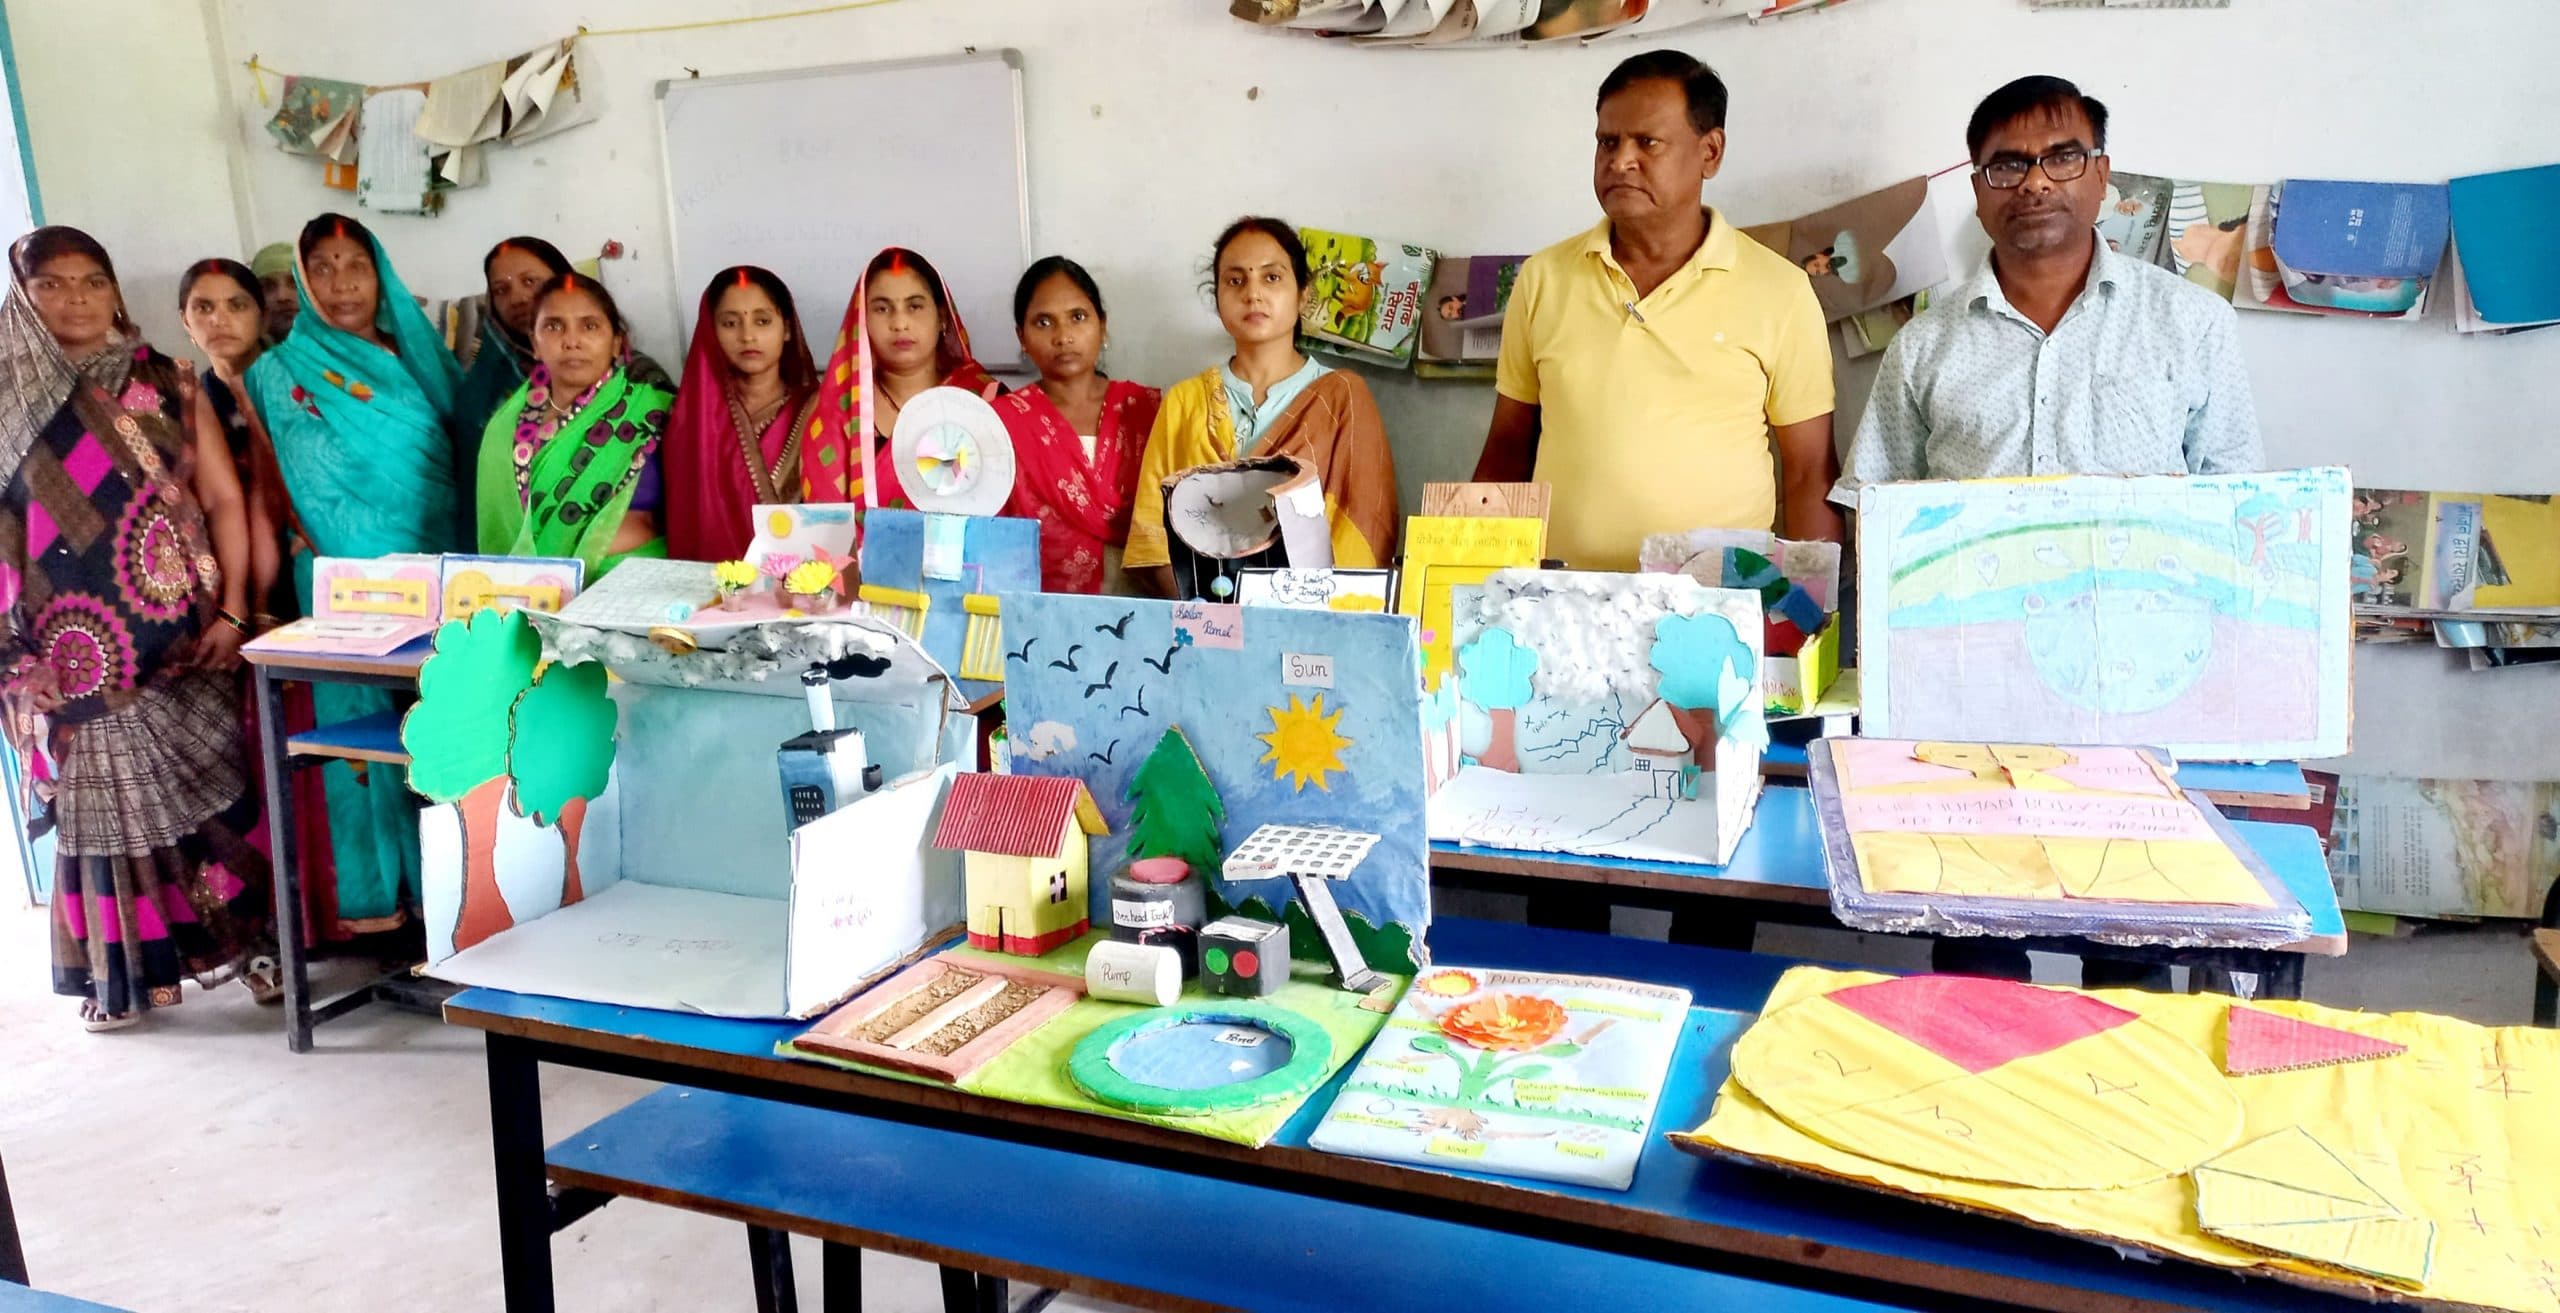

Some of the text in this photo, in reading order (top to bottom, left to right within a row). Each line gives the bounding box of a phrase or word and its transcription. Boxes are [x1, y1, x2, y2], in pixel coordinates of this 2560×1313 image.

[1380, 290, 1404, 334] सियार
[1399, 280, 1421, 329] चालाक
[1174, 603, 1203, 621] Solar
[1202, 619, 1234, 639] Panel
[1290, 655, 1328, 679] Sun
[1101, 962, 1132, 987] Pump
[1226, 1032, 1257, 1045] Pond
[1813, 1049, 1870, 1078] 2
[2087, 1070, 2152, 1107] 4
